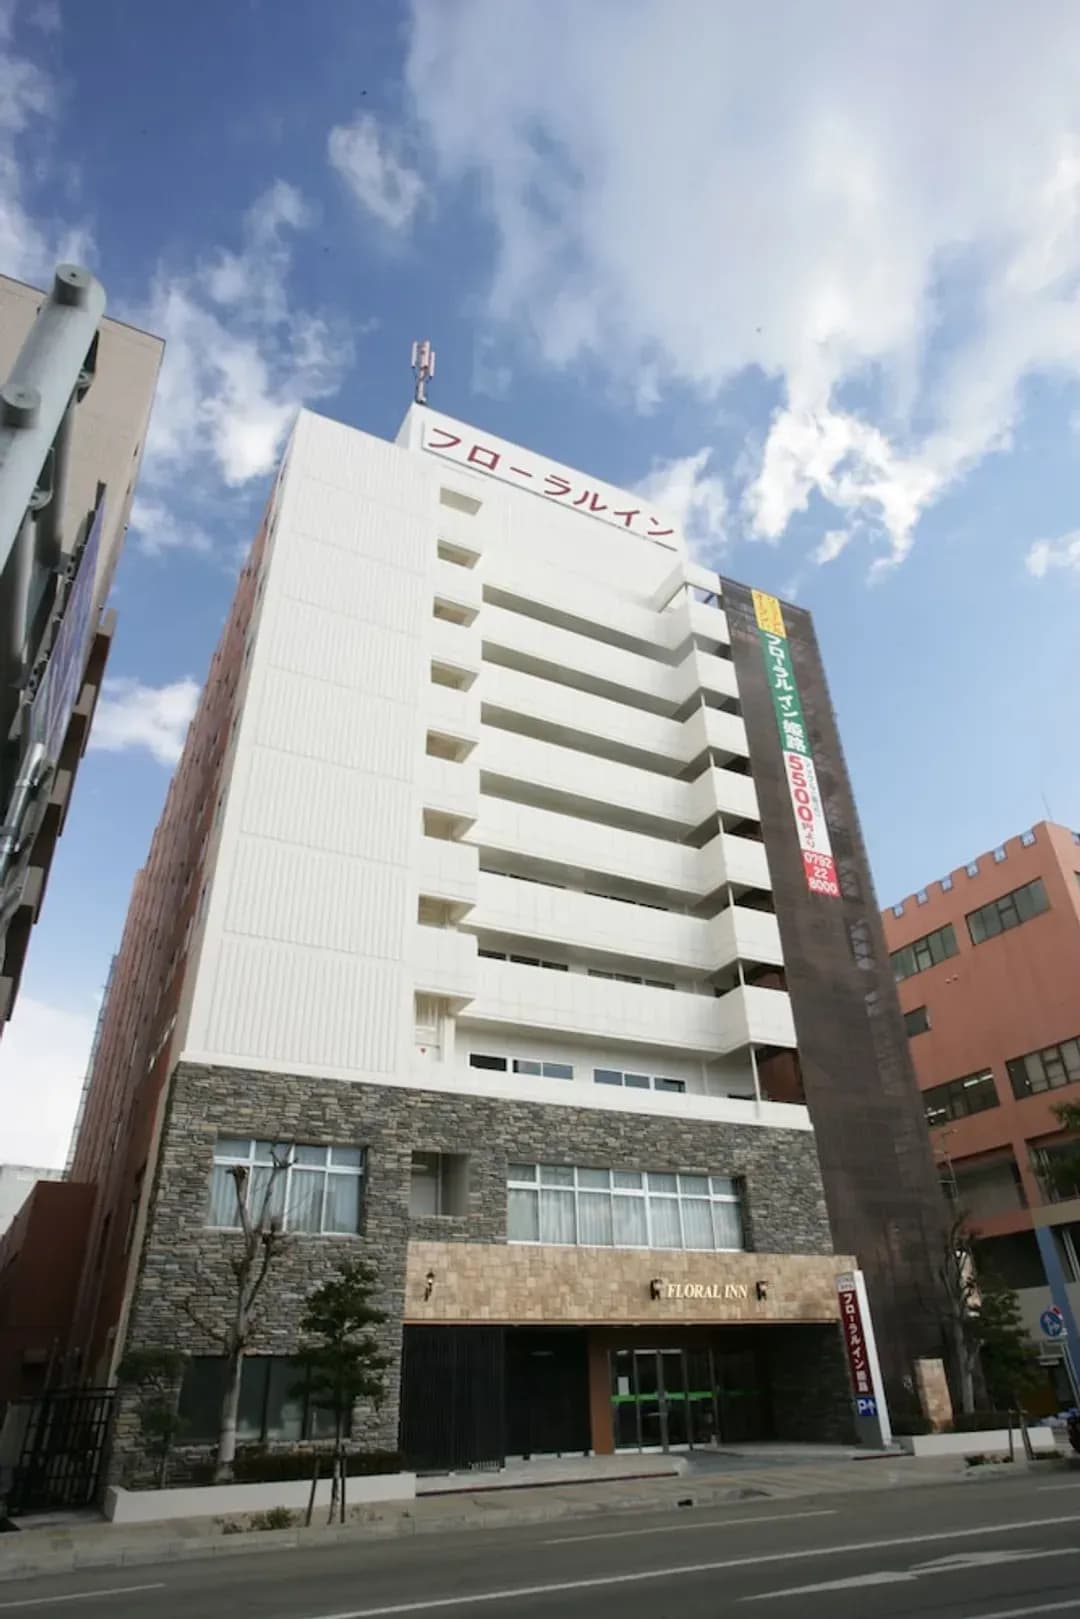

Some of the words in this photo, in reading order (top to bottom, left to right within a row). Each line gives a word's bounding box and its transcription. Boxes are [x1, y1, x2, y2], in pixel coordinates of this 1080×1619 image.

[428, 428, 675, 536] フローラルイン
[813, 865, 829, 879] 22
[667, 1283, 721, 1299] FLORAL
[724, 1284, 748, 1299] INN
[857, 1399, 867, 1415] P
